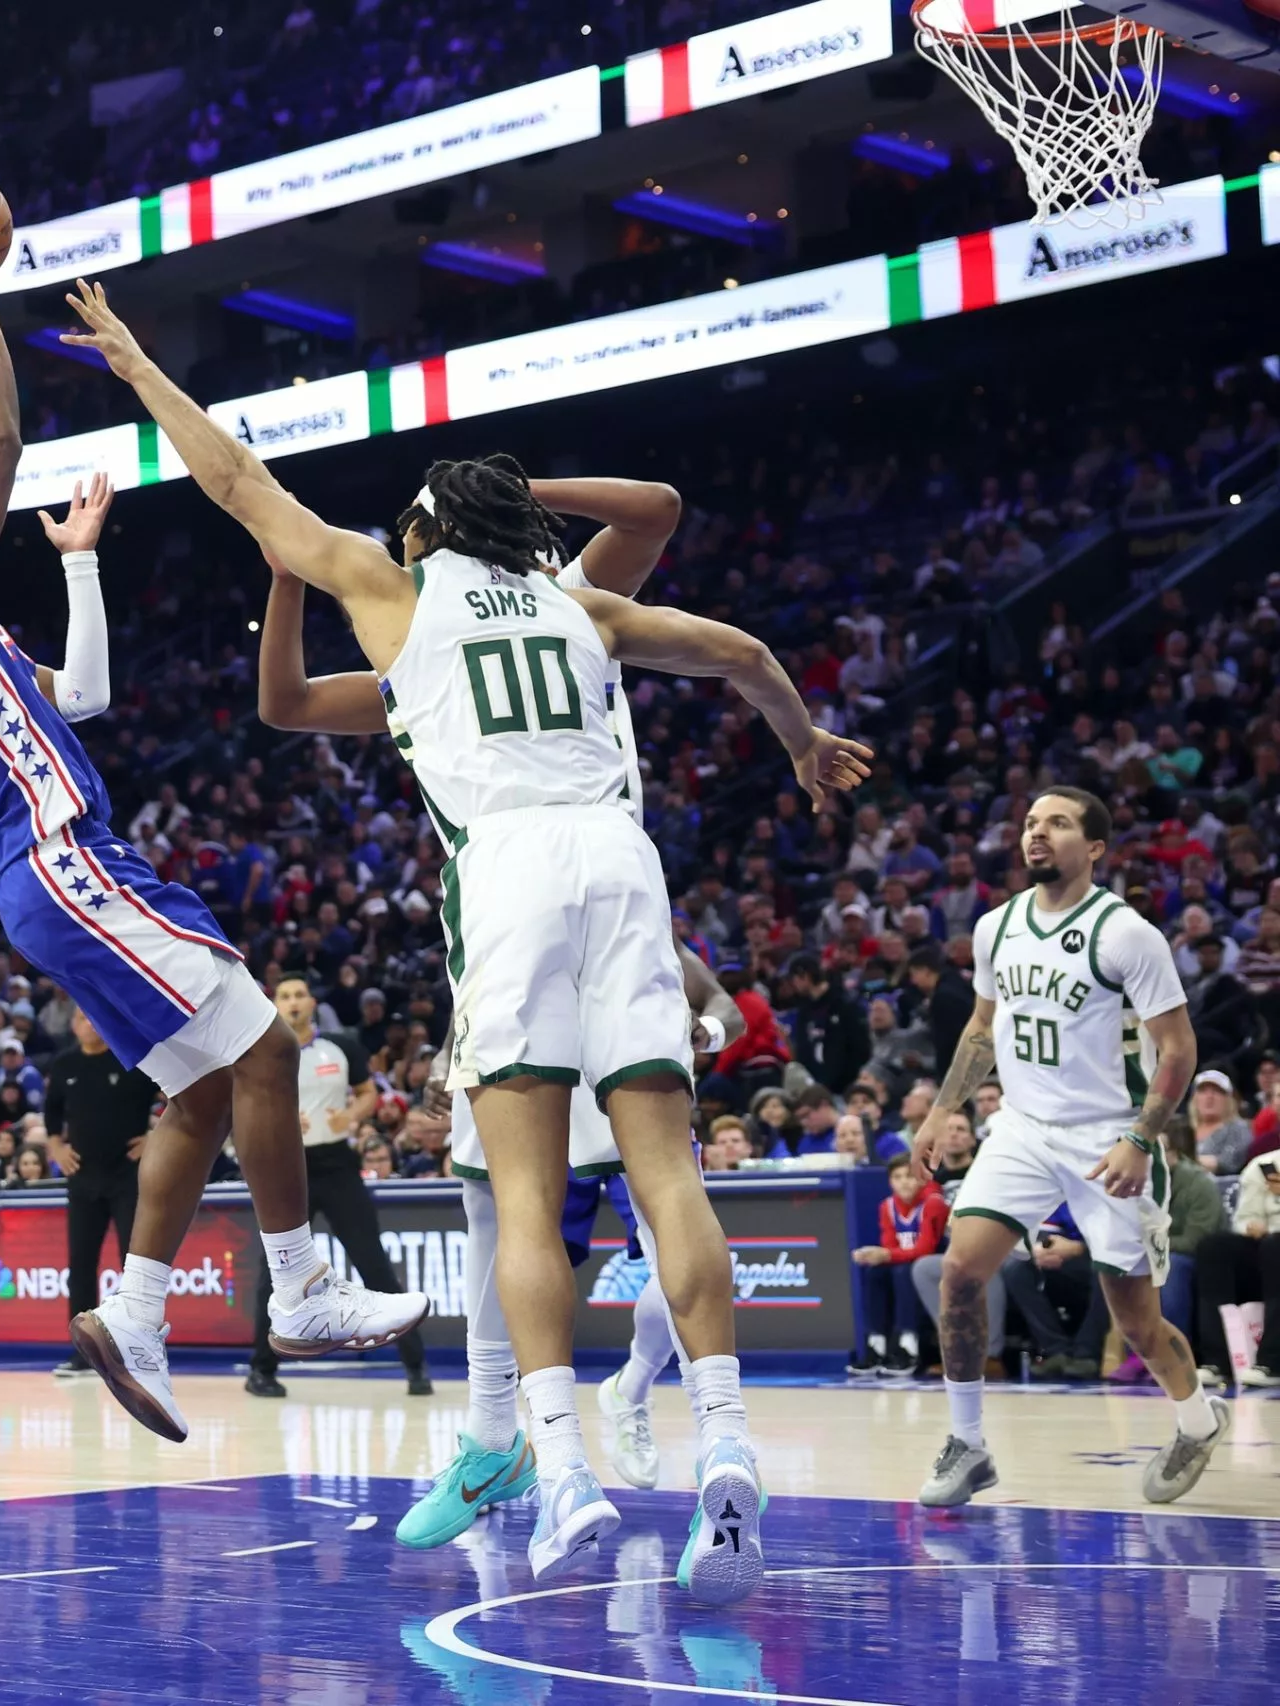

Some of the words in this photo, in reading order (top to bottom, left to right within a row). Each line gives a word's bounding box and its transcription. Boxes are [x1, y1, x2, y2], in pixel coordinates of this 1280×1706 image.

[1026, 219, 1195, 277] Amoroso's
[465, 588, 538, 621] SIMS
[461, 636, 584, 737] 00
[996, 963, 1092, 1013] BUCKS
[1013, 1013, 1060, 1067] 50
[729, 1251, 809, 1299] ngeles
